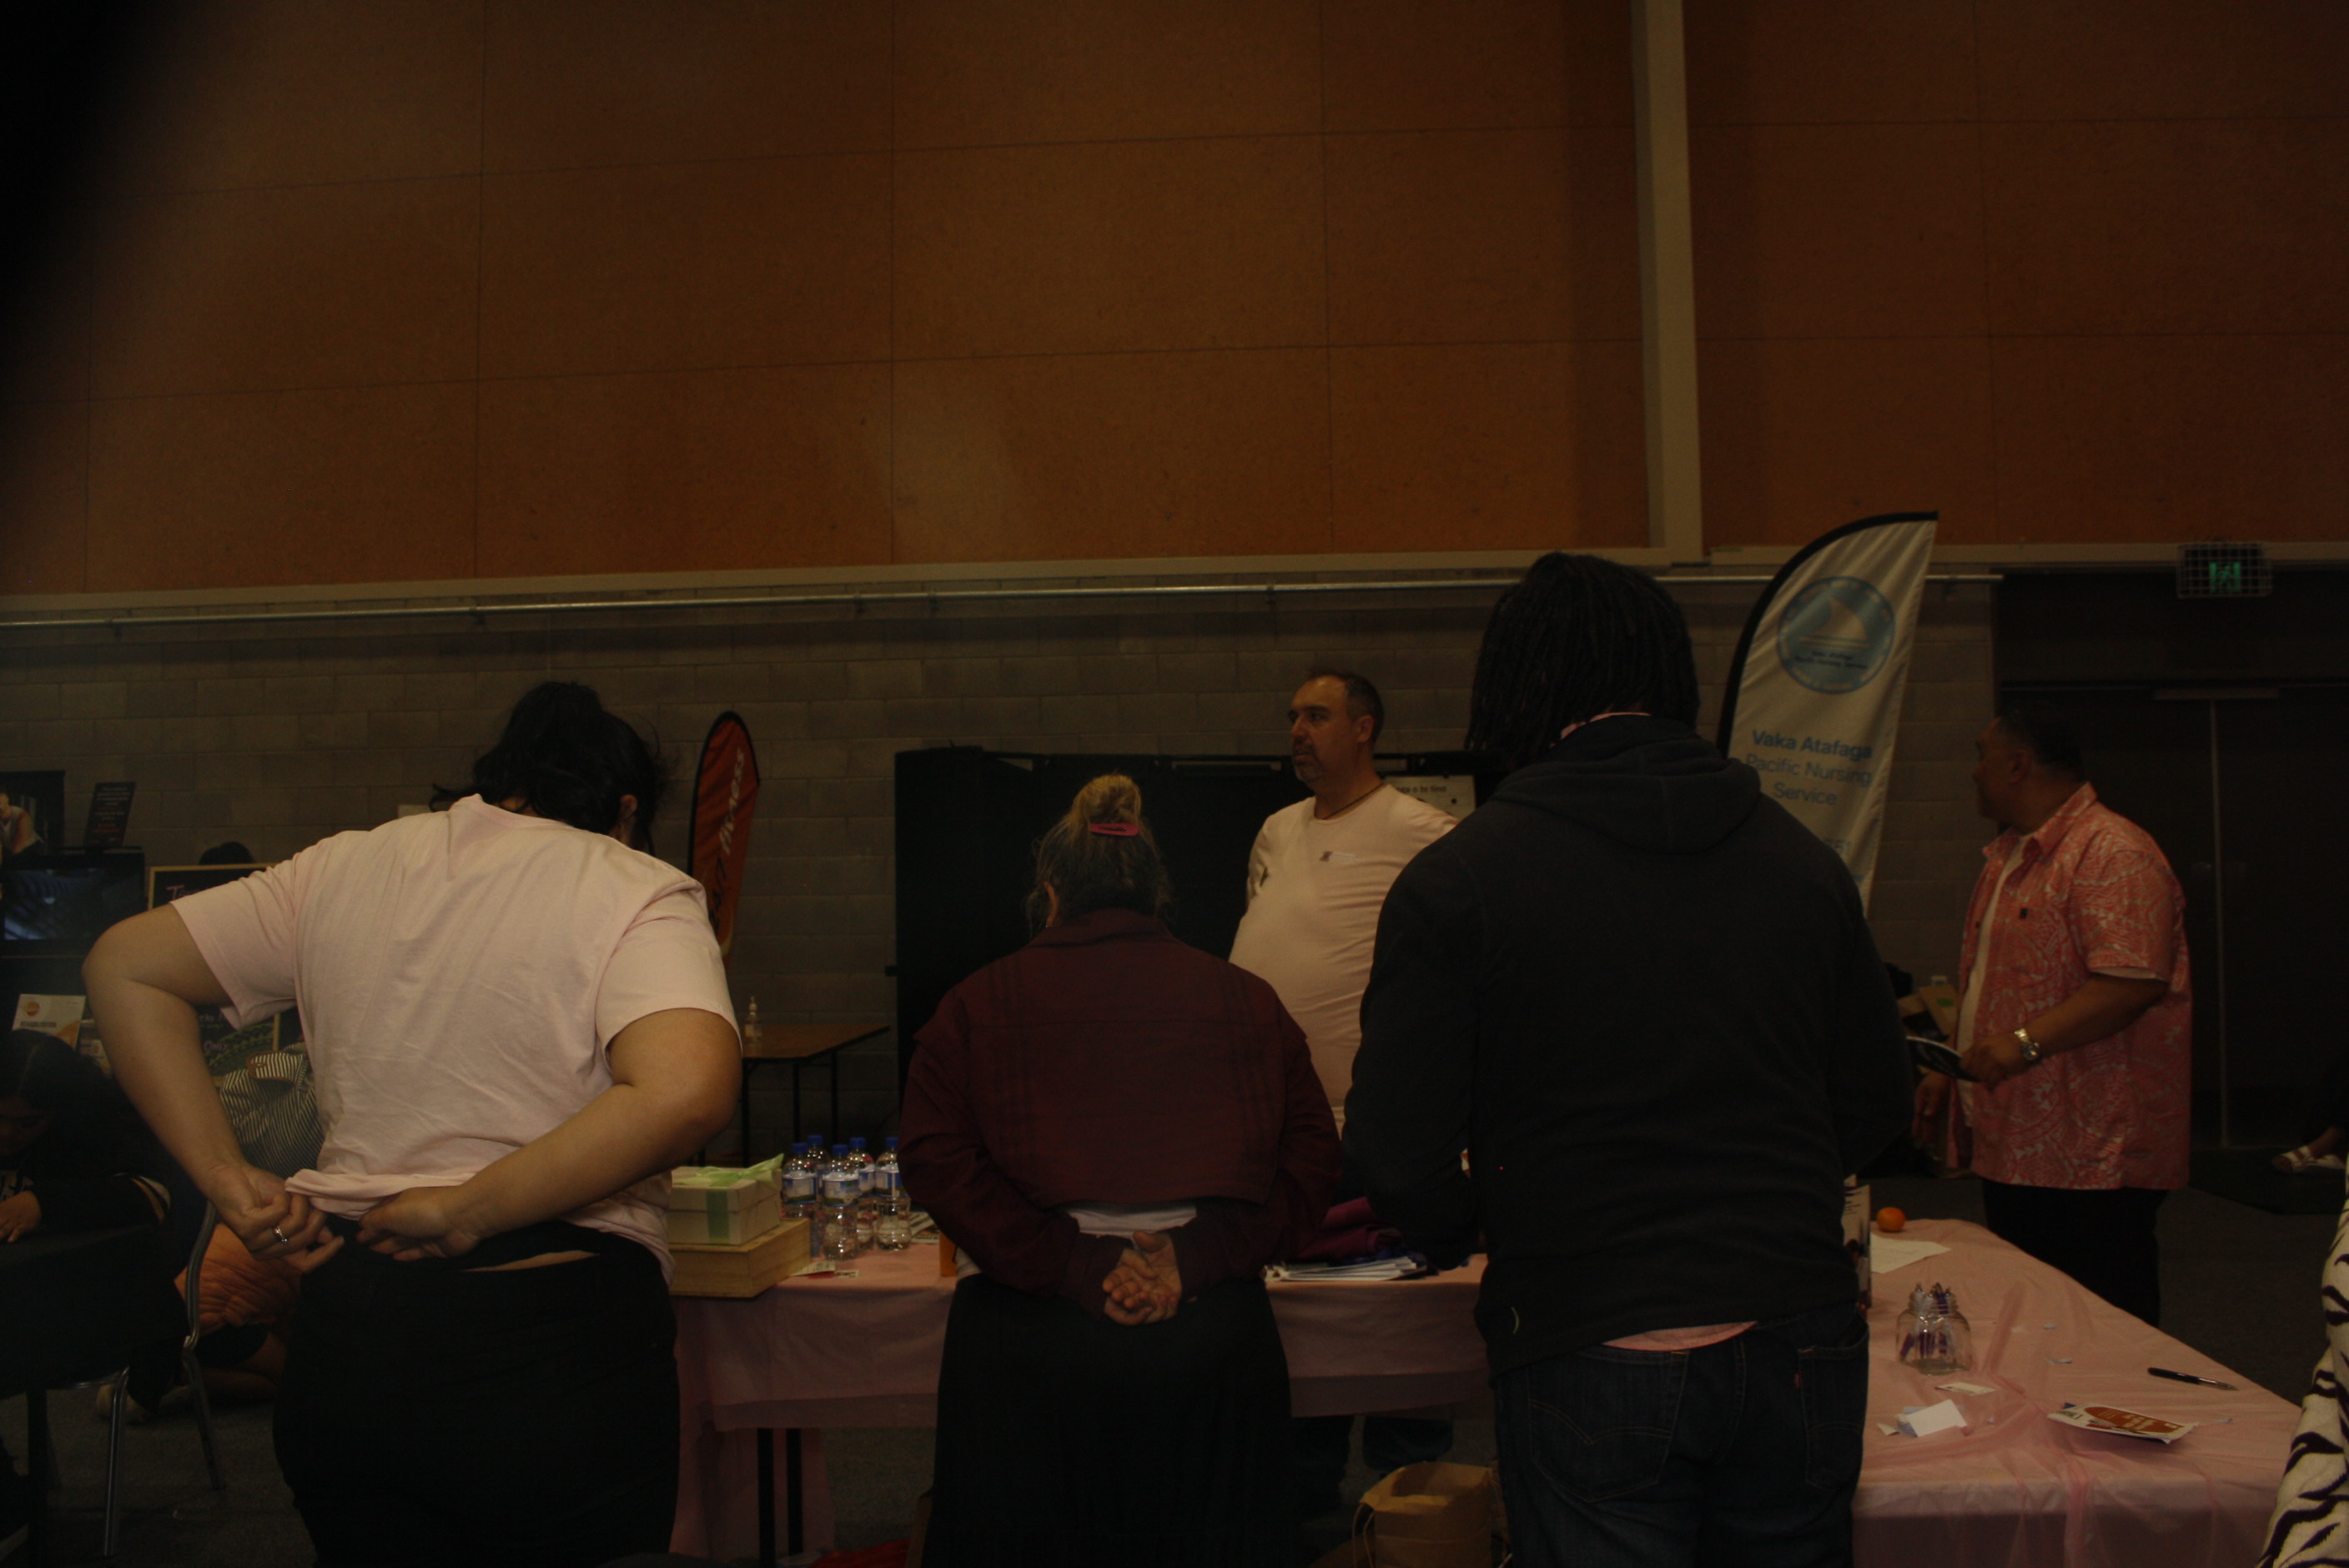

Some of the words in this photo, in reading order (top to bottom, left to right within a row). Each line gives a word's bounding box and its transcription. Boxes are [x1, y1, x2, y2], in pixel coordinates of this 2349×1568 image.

[1752, 729, 1797, 749] Vaka
[1801, 736, 1873, 762] Atafaga
[1746, 753, 1800, 776] Pacific
[1805, 761, 1872, 787] Nursing
[1773, 782, 1838, 806] Service
